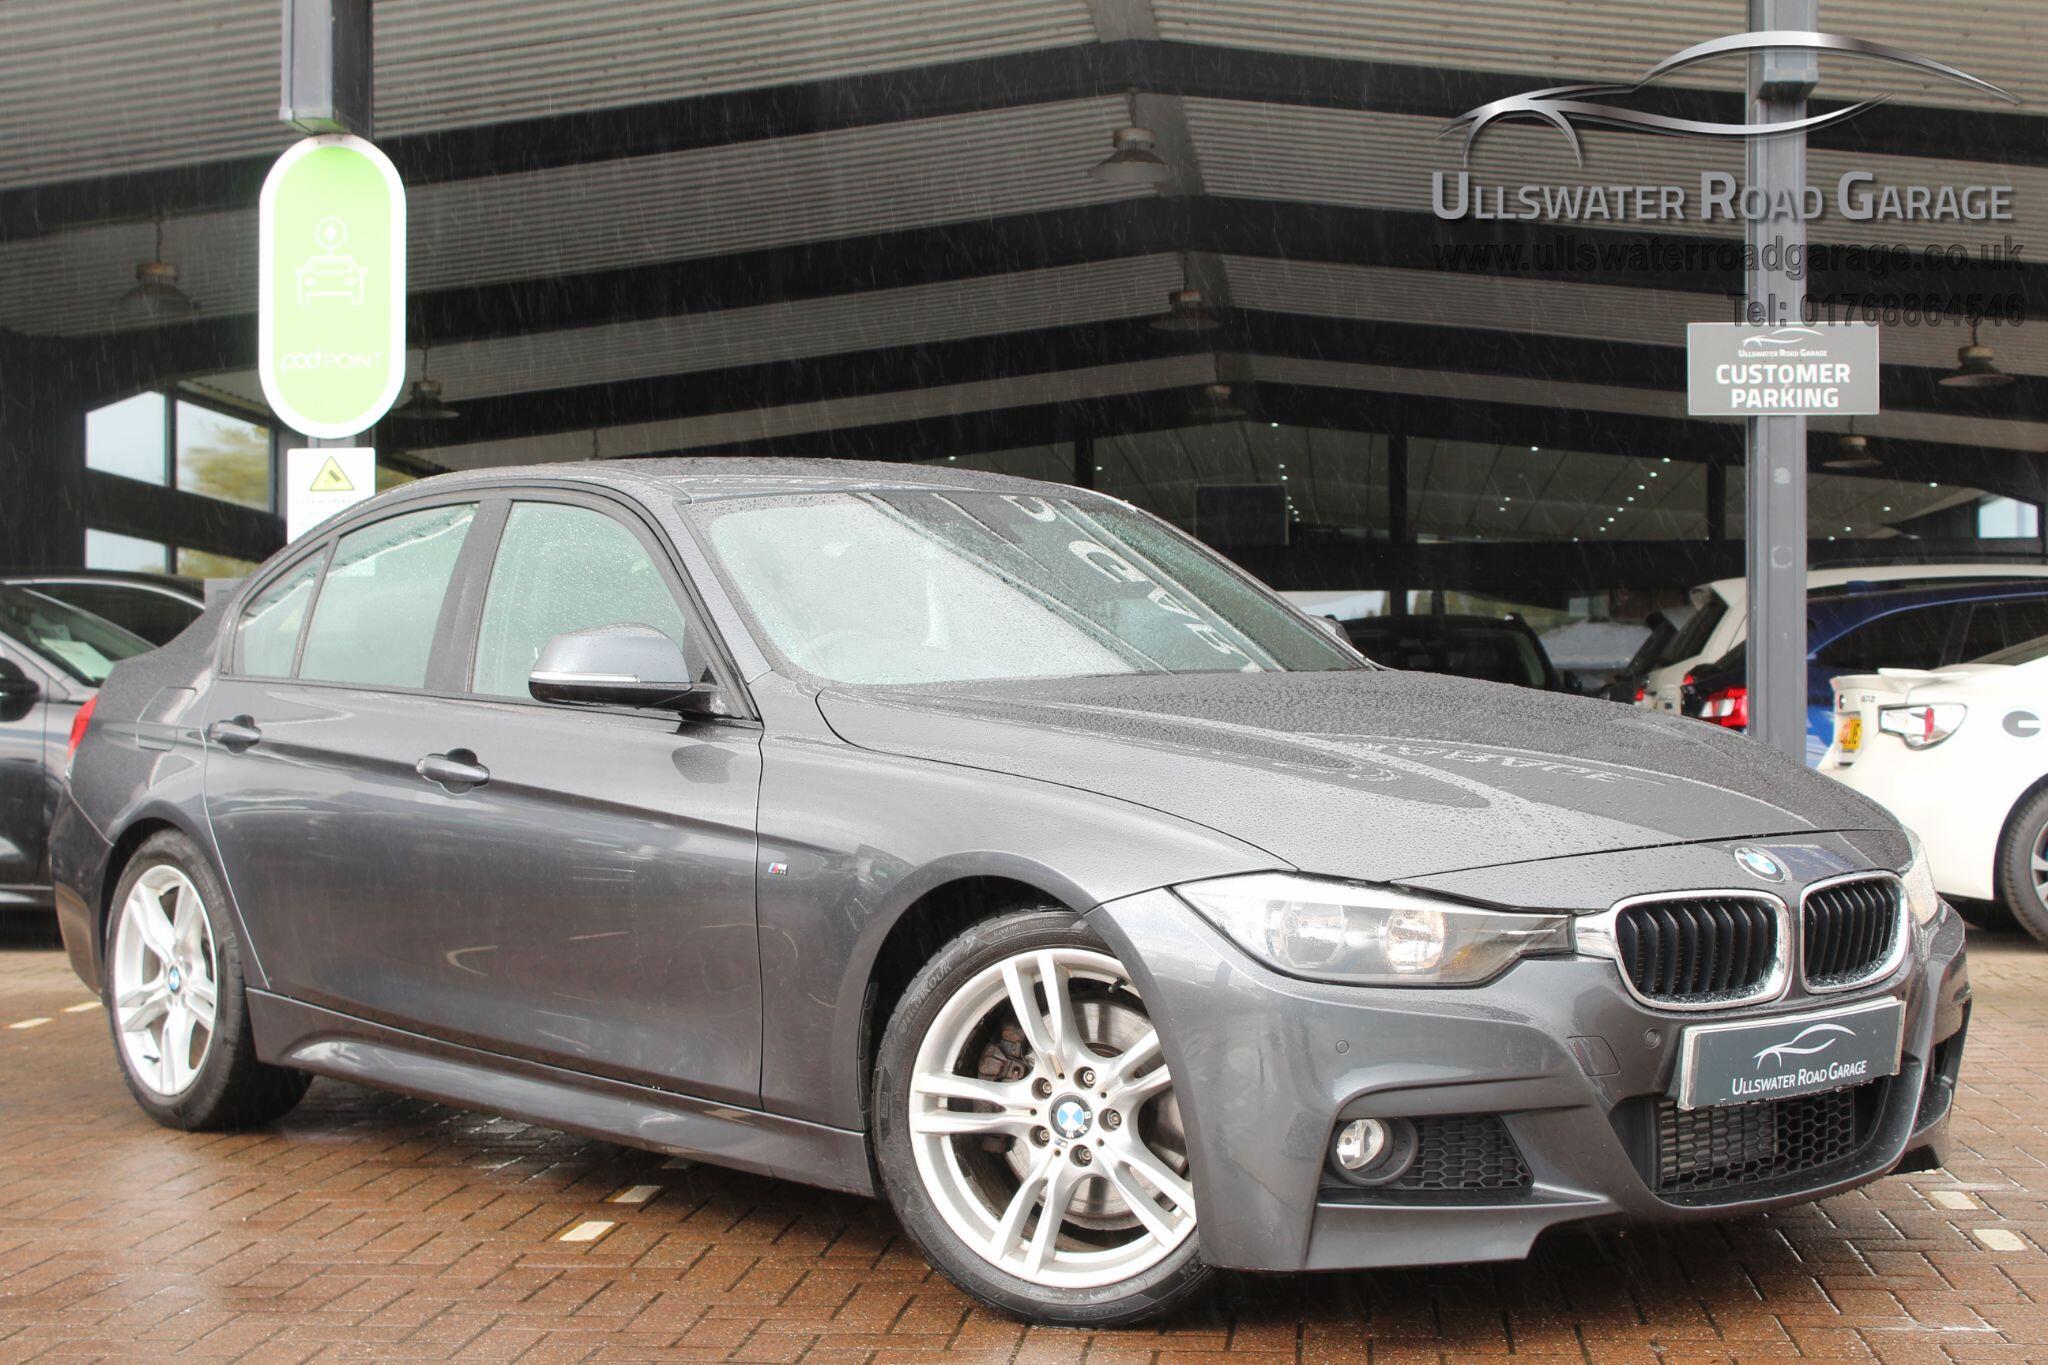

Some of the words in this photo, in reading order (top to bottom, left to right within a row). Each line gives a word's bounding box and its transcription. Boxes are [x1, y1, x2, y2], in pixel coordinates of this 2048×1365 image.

[1738, 349, 1778, 358] ULLSWATER
[1779, 349, 1798, 358] ROAD
[1800, 349, 1828, 358] GARAGE
[1715, 363, 1851, 385] CUSTOMER
[1731, 388, 1839, 408] PARKING
[1732, 1074, 1796, 1095] ULLSWATER
[1797, 1068, 1828, 1086] ROAD
[1828, 1060, 1868, 1080] GARAGE
